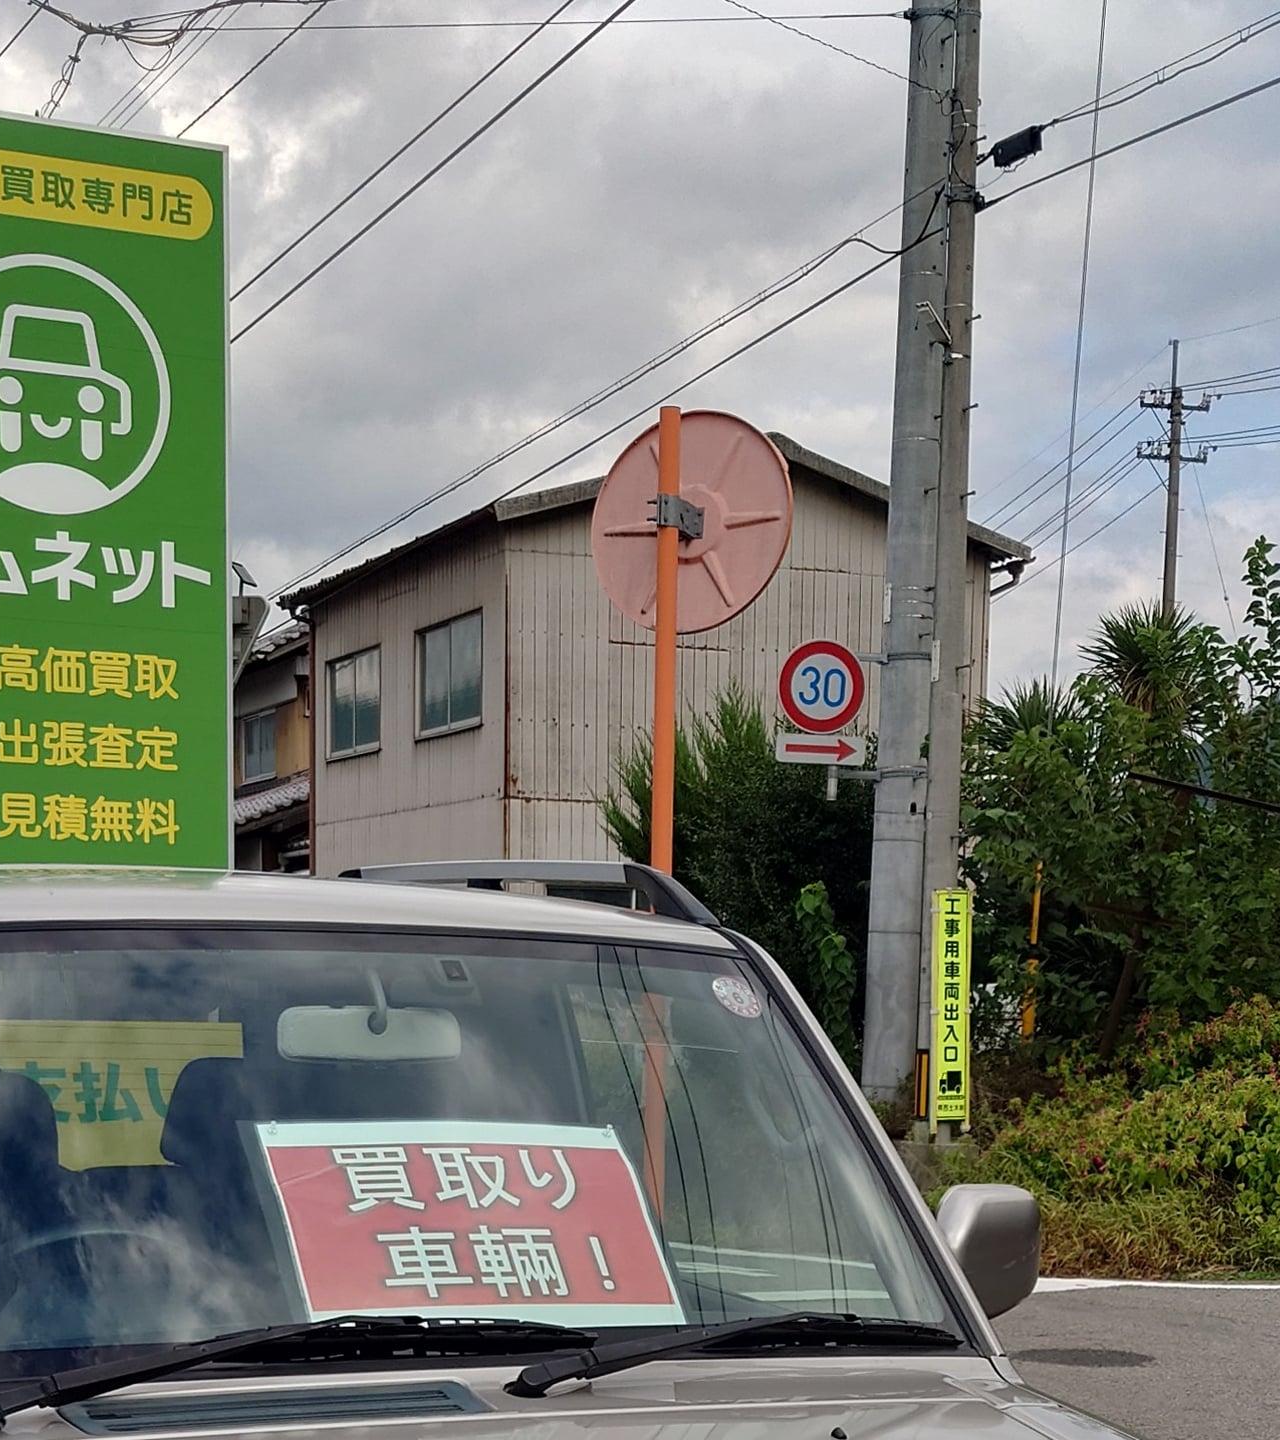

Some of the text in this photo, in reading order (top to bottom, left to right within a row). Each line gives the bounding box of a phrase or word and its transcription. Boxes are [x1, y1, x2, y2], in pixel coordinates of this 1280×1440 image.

[798, 665, 847, 706] 30
[943, 897, 961, 1063] 工事用車両出入口
[331, 1145, 577, 1213] 買取り
